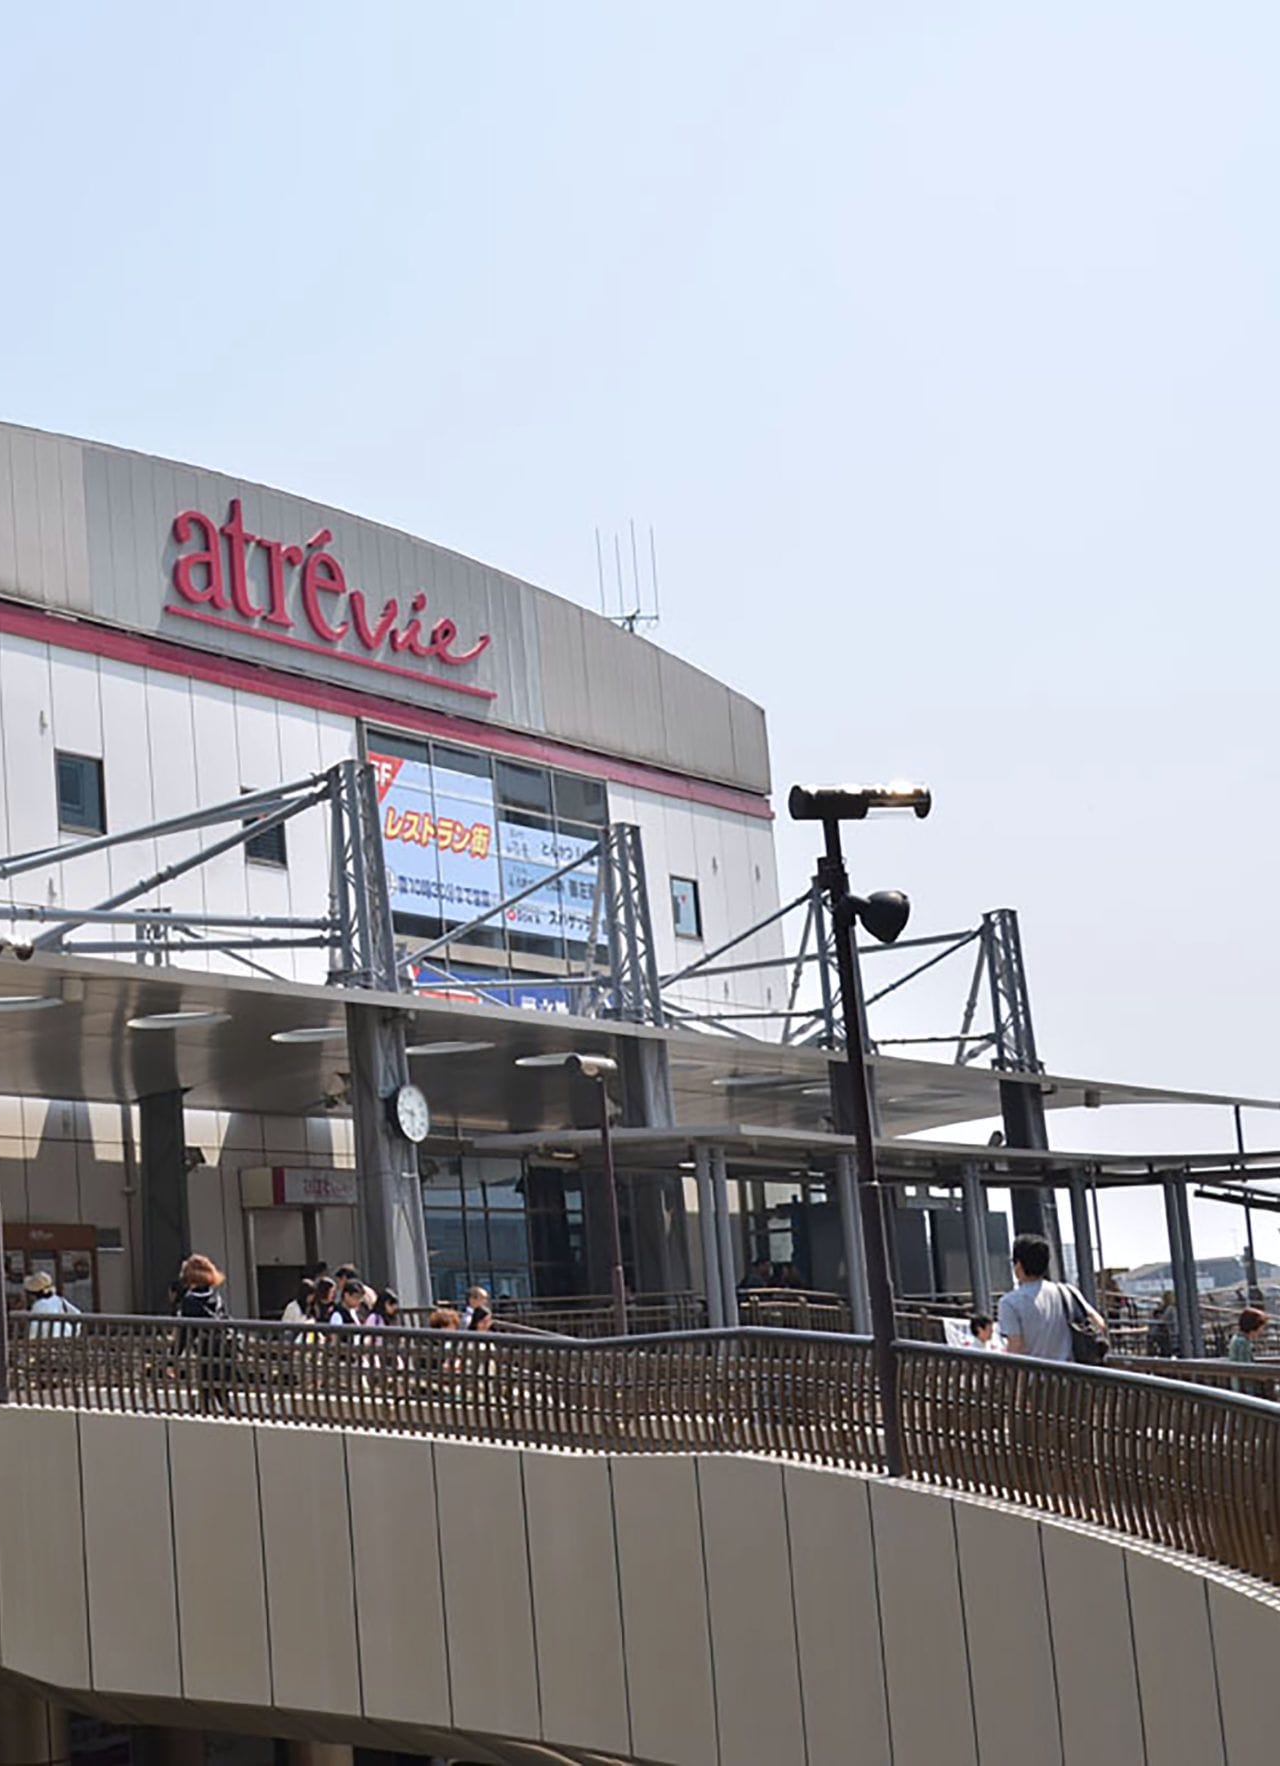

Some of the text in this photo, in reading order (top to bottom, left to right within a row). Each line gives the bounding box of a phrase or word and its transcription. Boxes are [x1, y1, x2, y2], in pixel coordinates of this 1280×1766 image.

[384, 806, 492, 860] レストラン街
